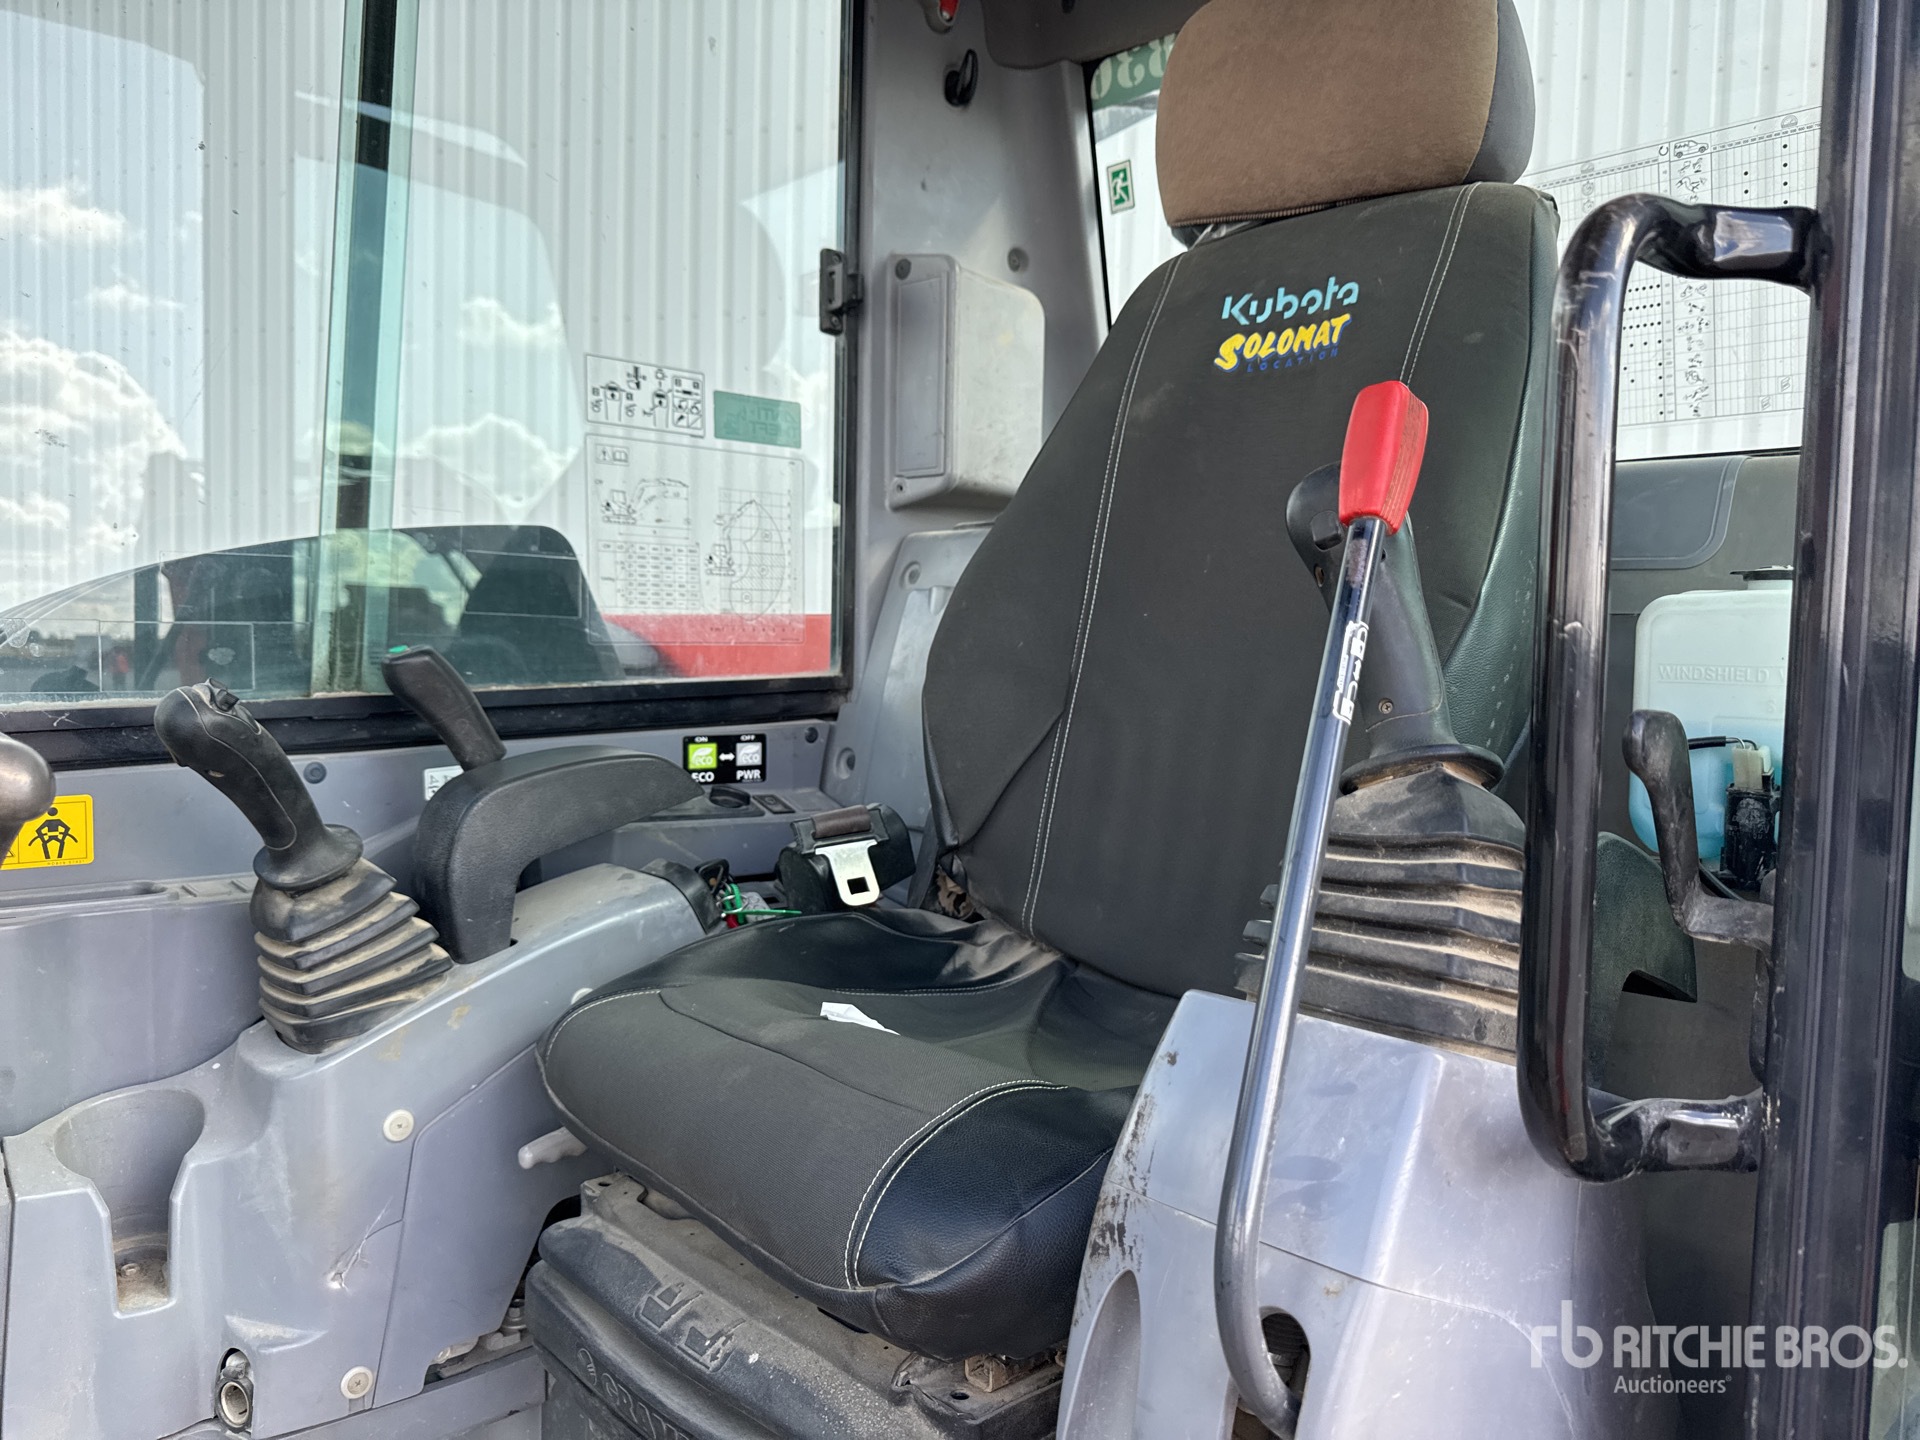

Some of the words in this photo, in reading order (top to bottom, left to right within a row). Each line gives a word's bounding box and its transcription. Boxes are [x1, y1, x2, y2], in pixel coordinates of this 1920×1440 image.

[1221, 275, 1360, 326] Kubota
[1214, 313, 1352, 373] SOLOMAT
[1247, 348, 1339, 373] LOCATION
[1658, 665, 1770, 684] WINDSHIELD
[736, 769, 761, 780] PWR
